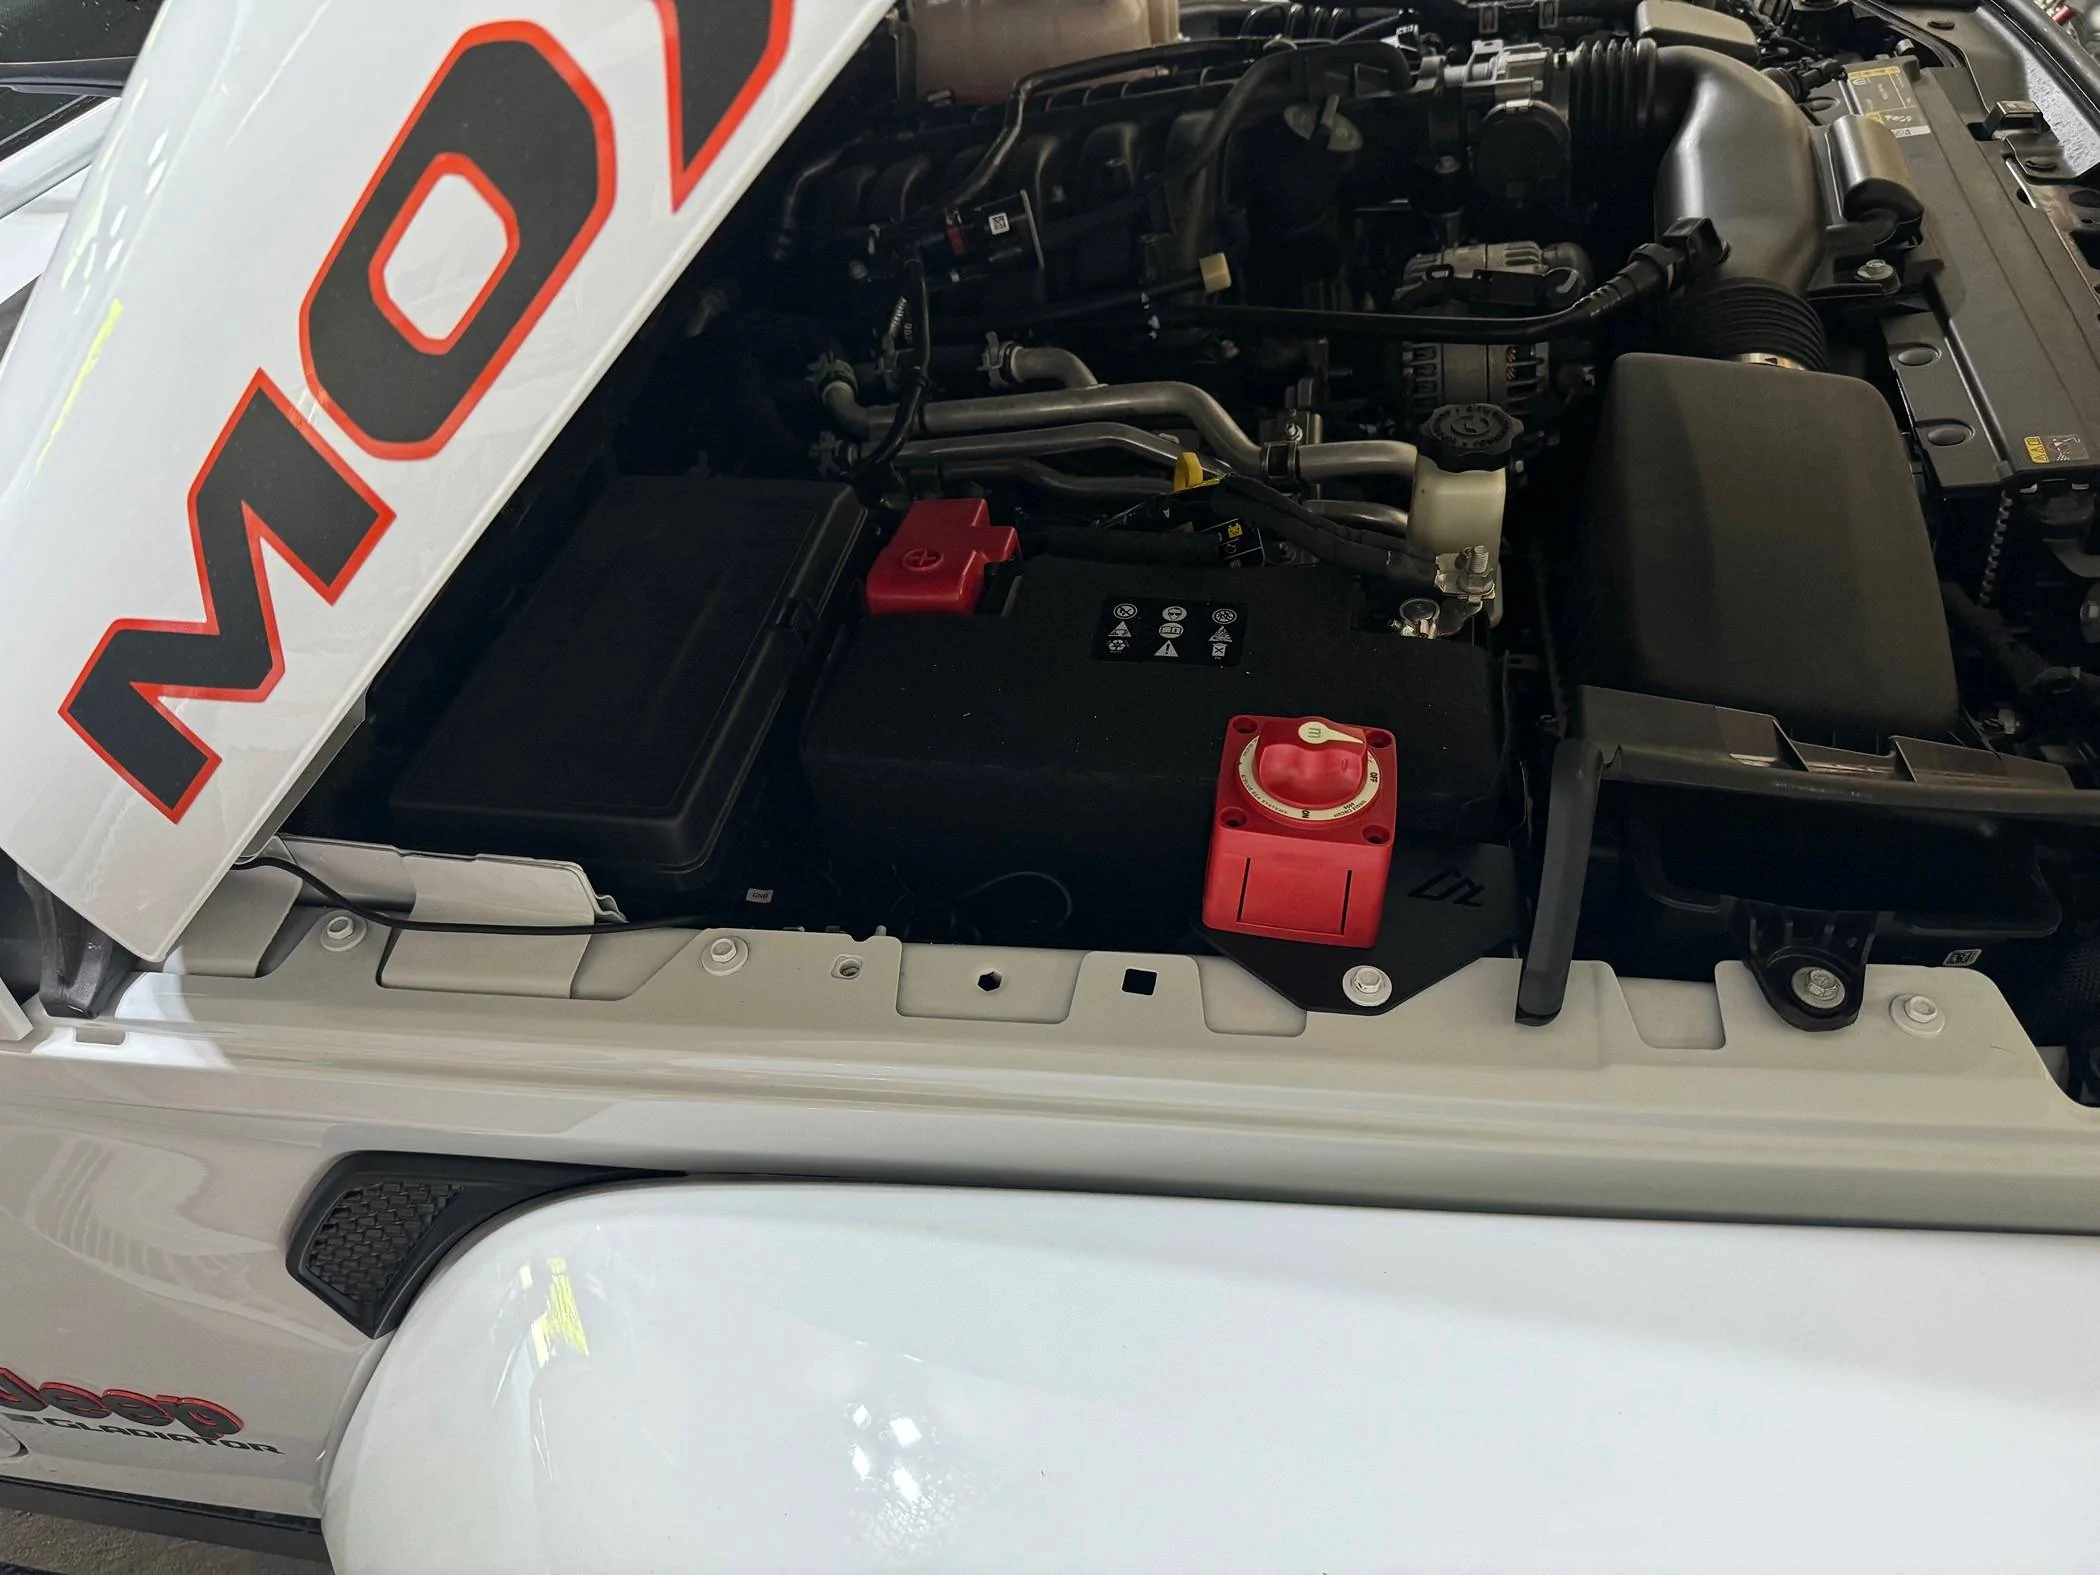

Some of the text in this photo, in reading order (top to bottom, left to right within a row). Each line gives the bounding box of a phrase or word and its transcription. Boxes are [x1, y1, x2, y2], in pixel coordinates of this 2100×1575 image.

[1369, 771, 1378, 783] OFF
[1301, 809, 1310, 819] ON
[43, 1417, 285, 1455] GLADIATOR
